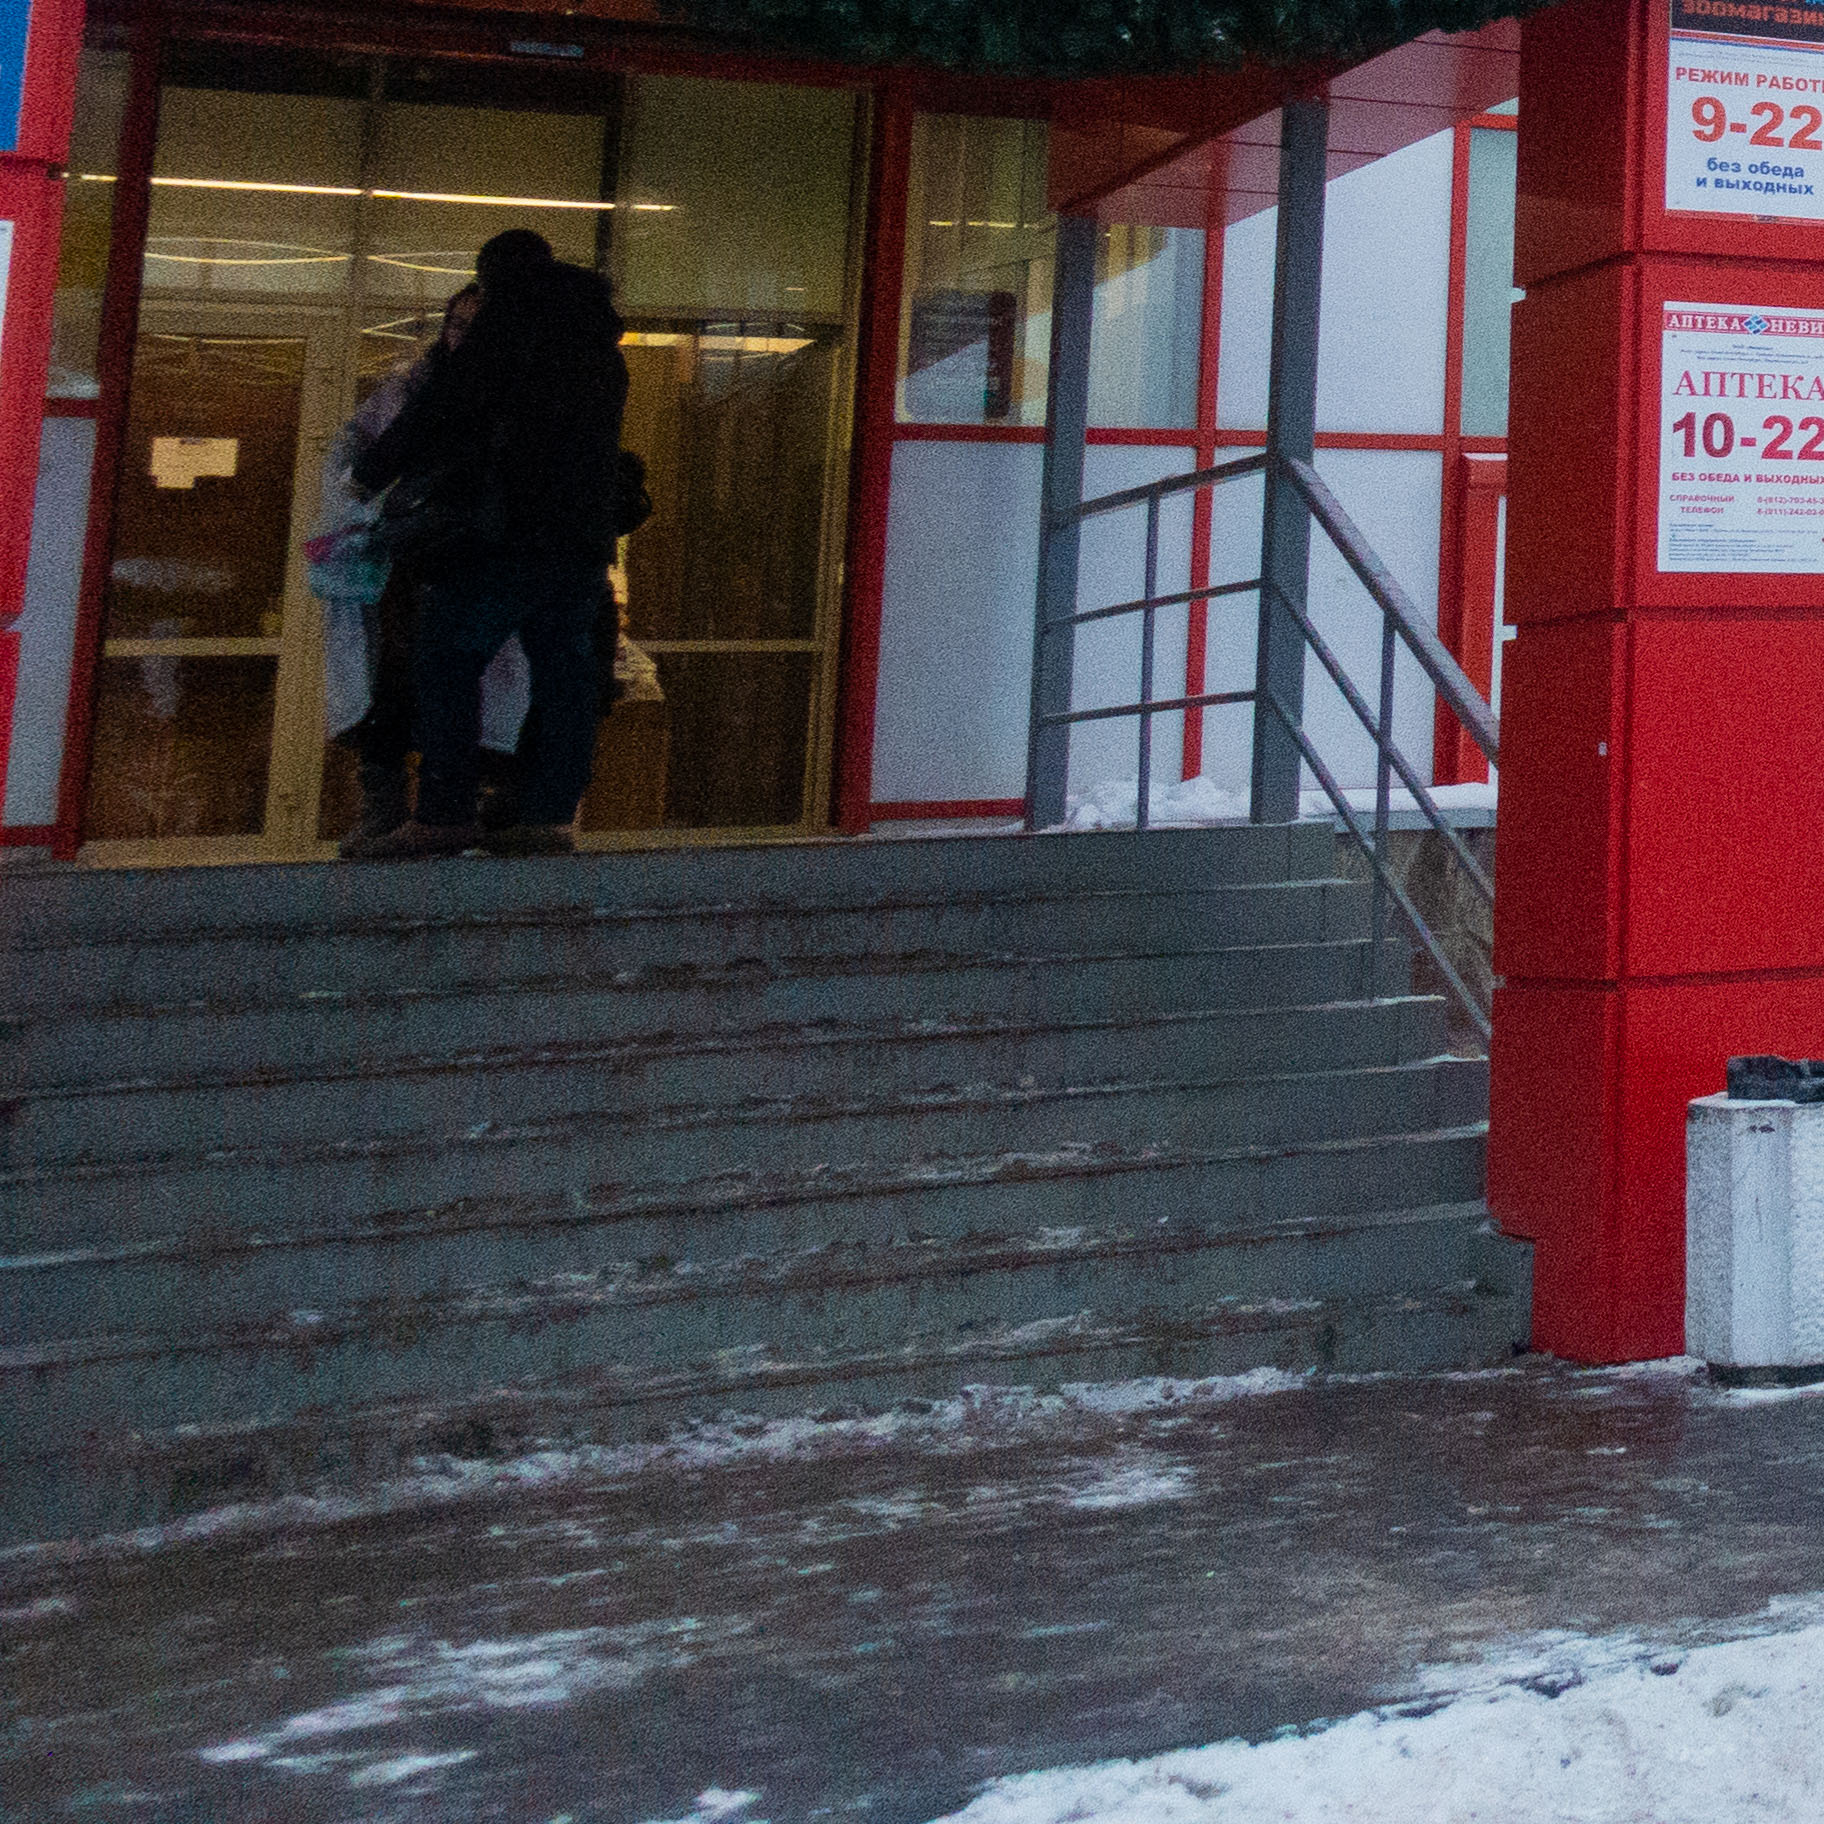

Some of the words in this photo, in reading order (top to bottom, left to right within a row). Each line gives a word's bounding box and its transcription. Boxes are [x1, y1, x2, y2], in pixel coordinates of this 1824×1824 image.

[1675, 66, 1749, 87] РЕЖИМ
[1691, 96, 1823, 151] 9-22
[1707, 157, 1741, 173] без
[1748, 161, 1805, 178] обеда
[1714, 178, 1814, 195] выходных
[1668, 314, 1741, 330] АПТЕКА
[1672, 473, 1695, 482] БЕЗ
[1699, 473, 1740, 483] ОБЕДА
